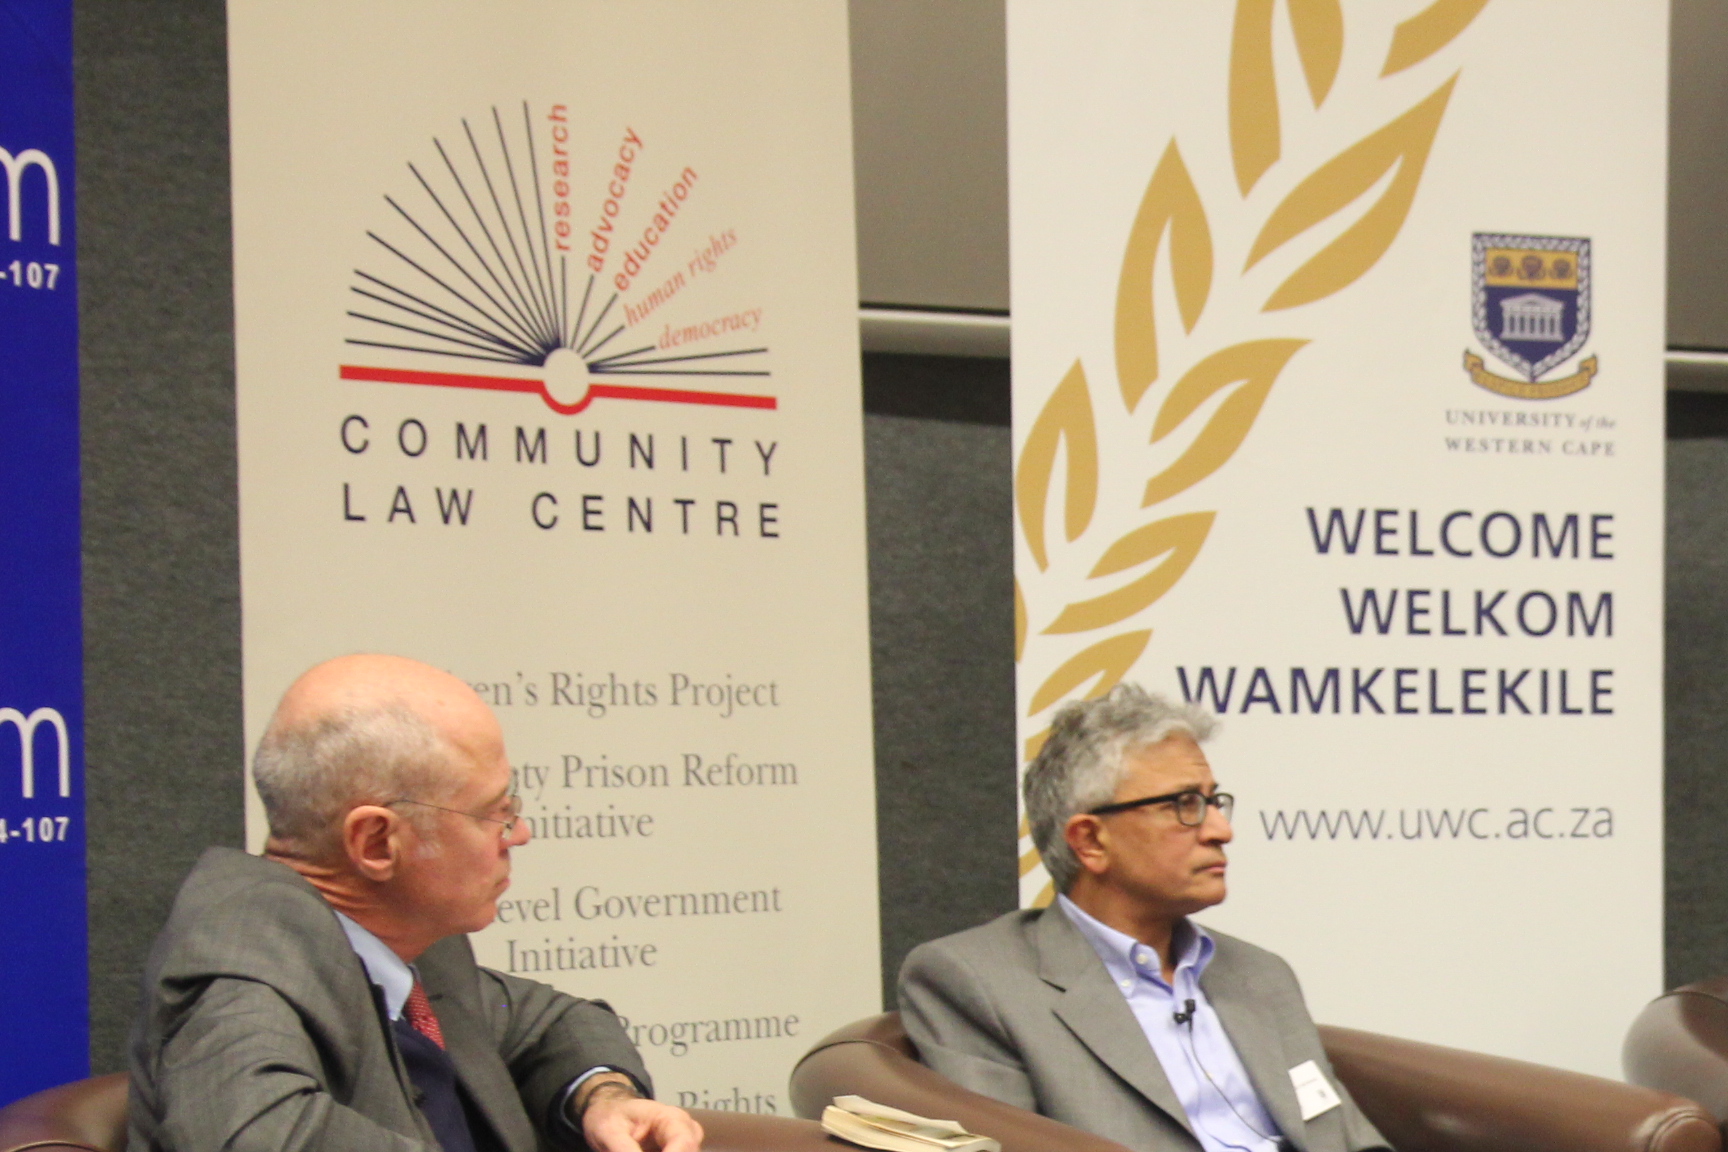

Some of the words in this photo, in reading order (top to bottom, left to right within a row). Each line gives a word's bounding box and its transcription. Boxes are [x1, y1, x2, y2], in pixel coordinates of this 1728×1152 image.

[547, 103, 572, 252] research
[587, 126, 644, 273] advocacy
[614, 166, 698, 291] education
[623, 272, 687, 327] human
[687, 228, 738, 278] rights
[658, 306, 763, 350] democracy
[339, 414, 778, 477] COMMUNITY
[1444, 409, 1575, 428] UNIVERSITY
[1578, 414, 1594, 433] of
[1444, 436, 1552, 454] WESTERN
[1560, 439, 1615, 457] CAPE
[342, 482, 474, 527] LAW
[530, 490, 780, 539] CENTRE
[1305, 505, 1615, 561] WELCOME
[1339, 586, 1614, 639] WELKOM
[467, 670, 539, 707] en's
[549, 671, 659, 719] Rights
[669, 672, 780, 719] Project
[1175, 665, 1615, 715] WAMKELEKILE
[560, 753, 670, 789] Prison
[681, 752, 799, 788] Reform
[526, 804, 655, 840] nitiative
[1258, 805, 1615, 842] www.uwc.ac.za
[495, 885, 562, 924] evel
[573, 885, 783, 921] Government
[505, 934, 658, 974] Initiative
